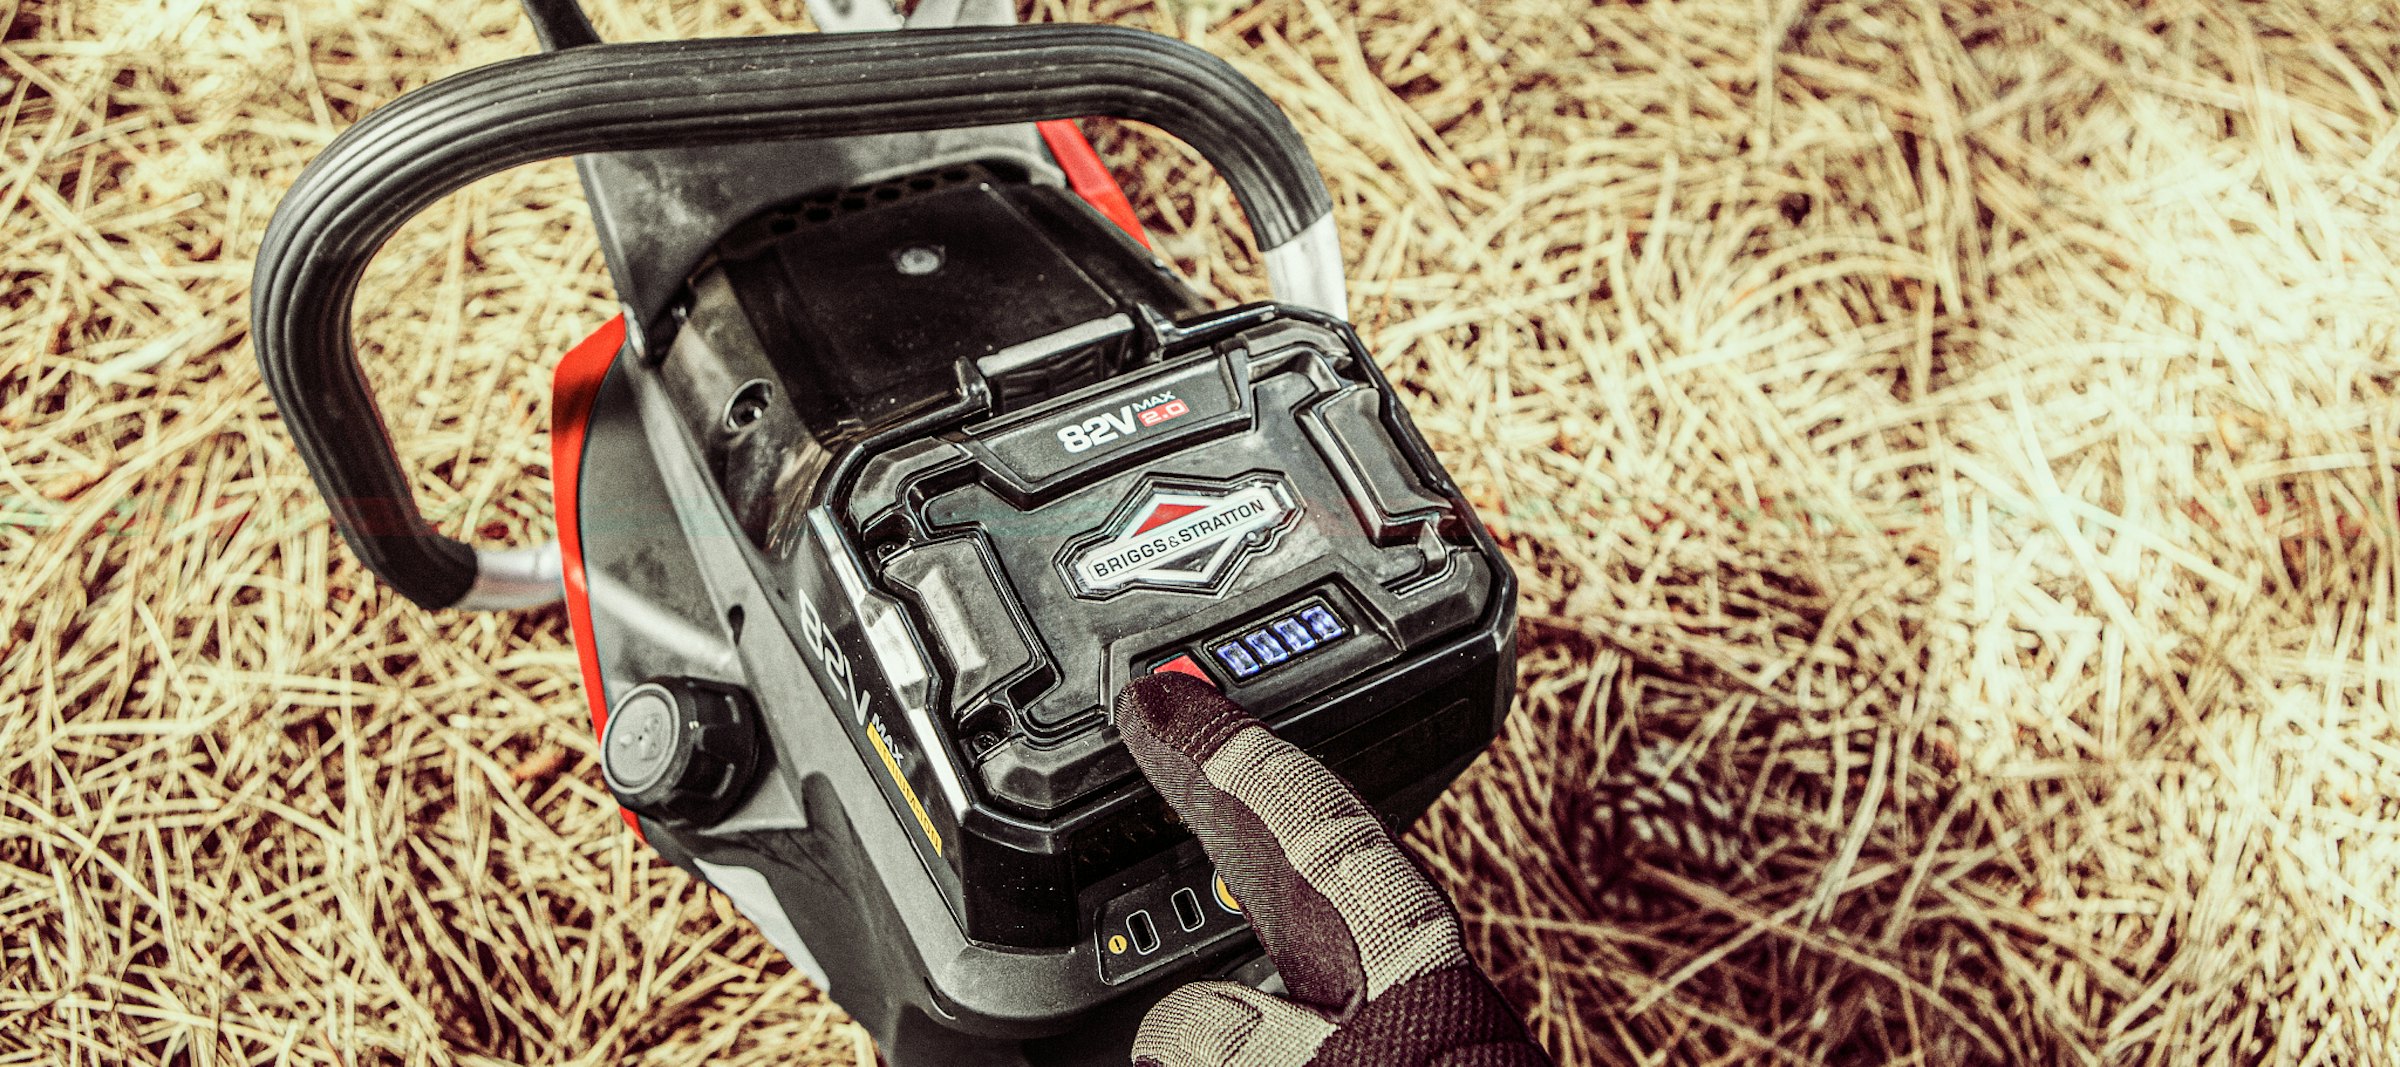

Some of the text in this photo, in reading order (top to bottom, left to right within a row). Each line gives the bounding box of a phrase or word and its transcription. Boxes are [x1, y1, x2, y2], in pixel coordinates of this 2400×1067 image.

[1057, 390, 1176, 453] 82V MAX
[1141, 402, 1185, 425] 2.0
[799, 589, 904, 768] 82V MAX
